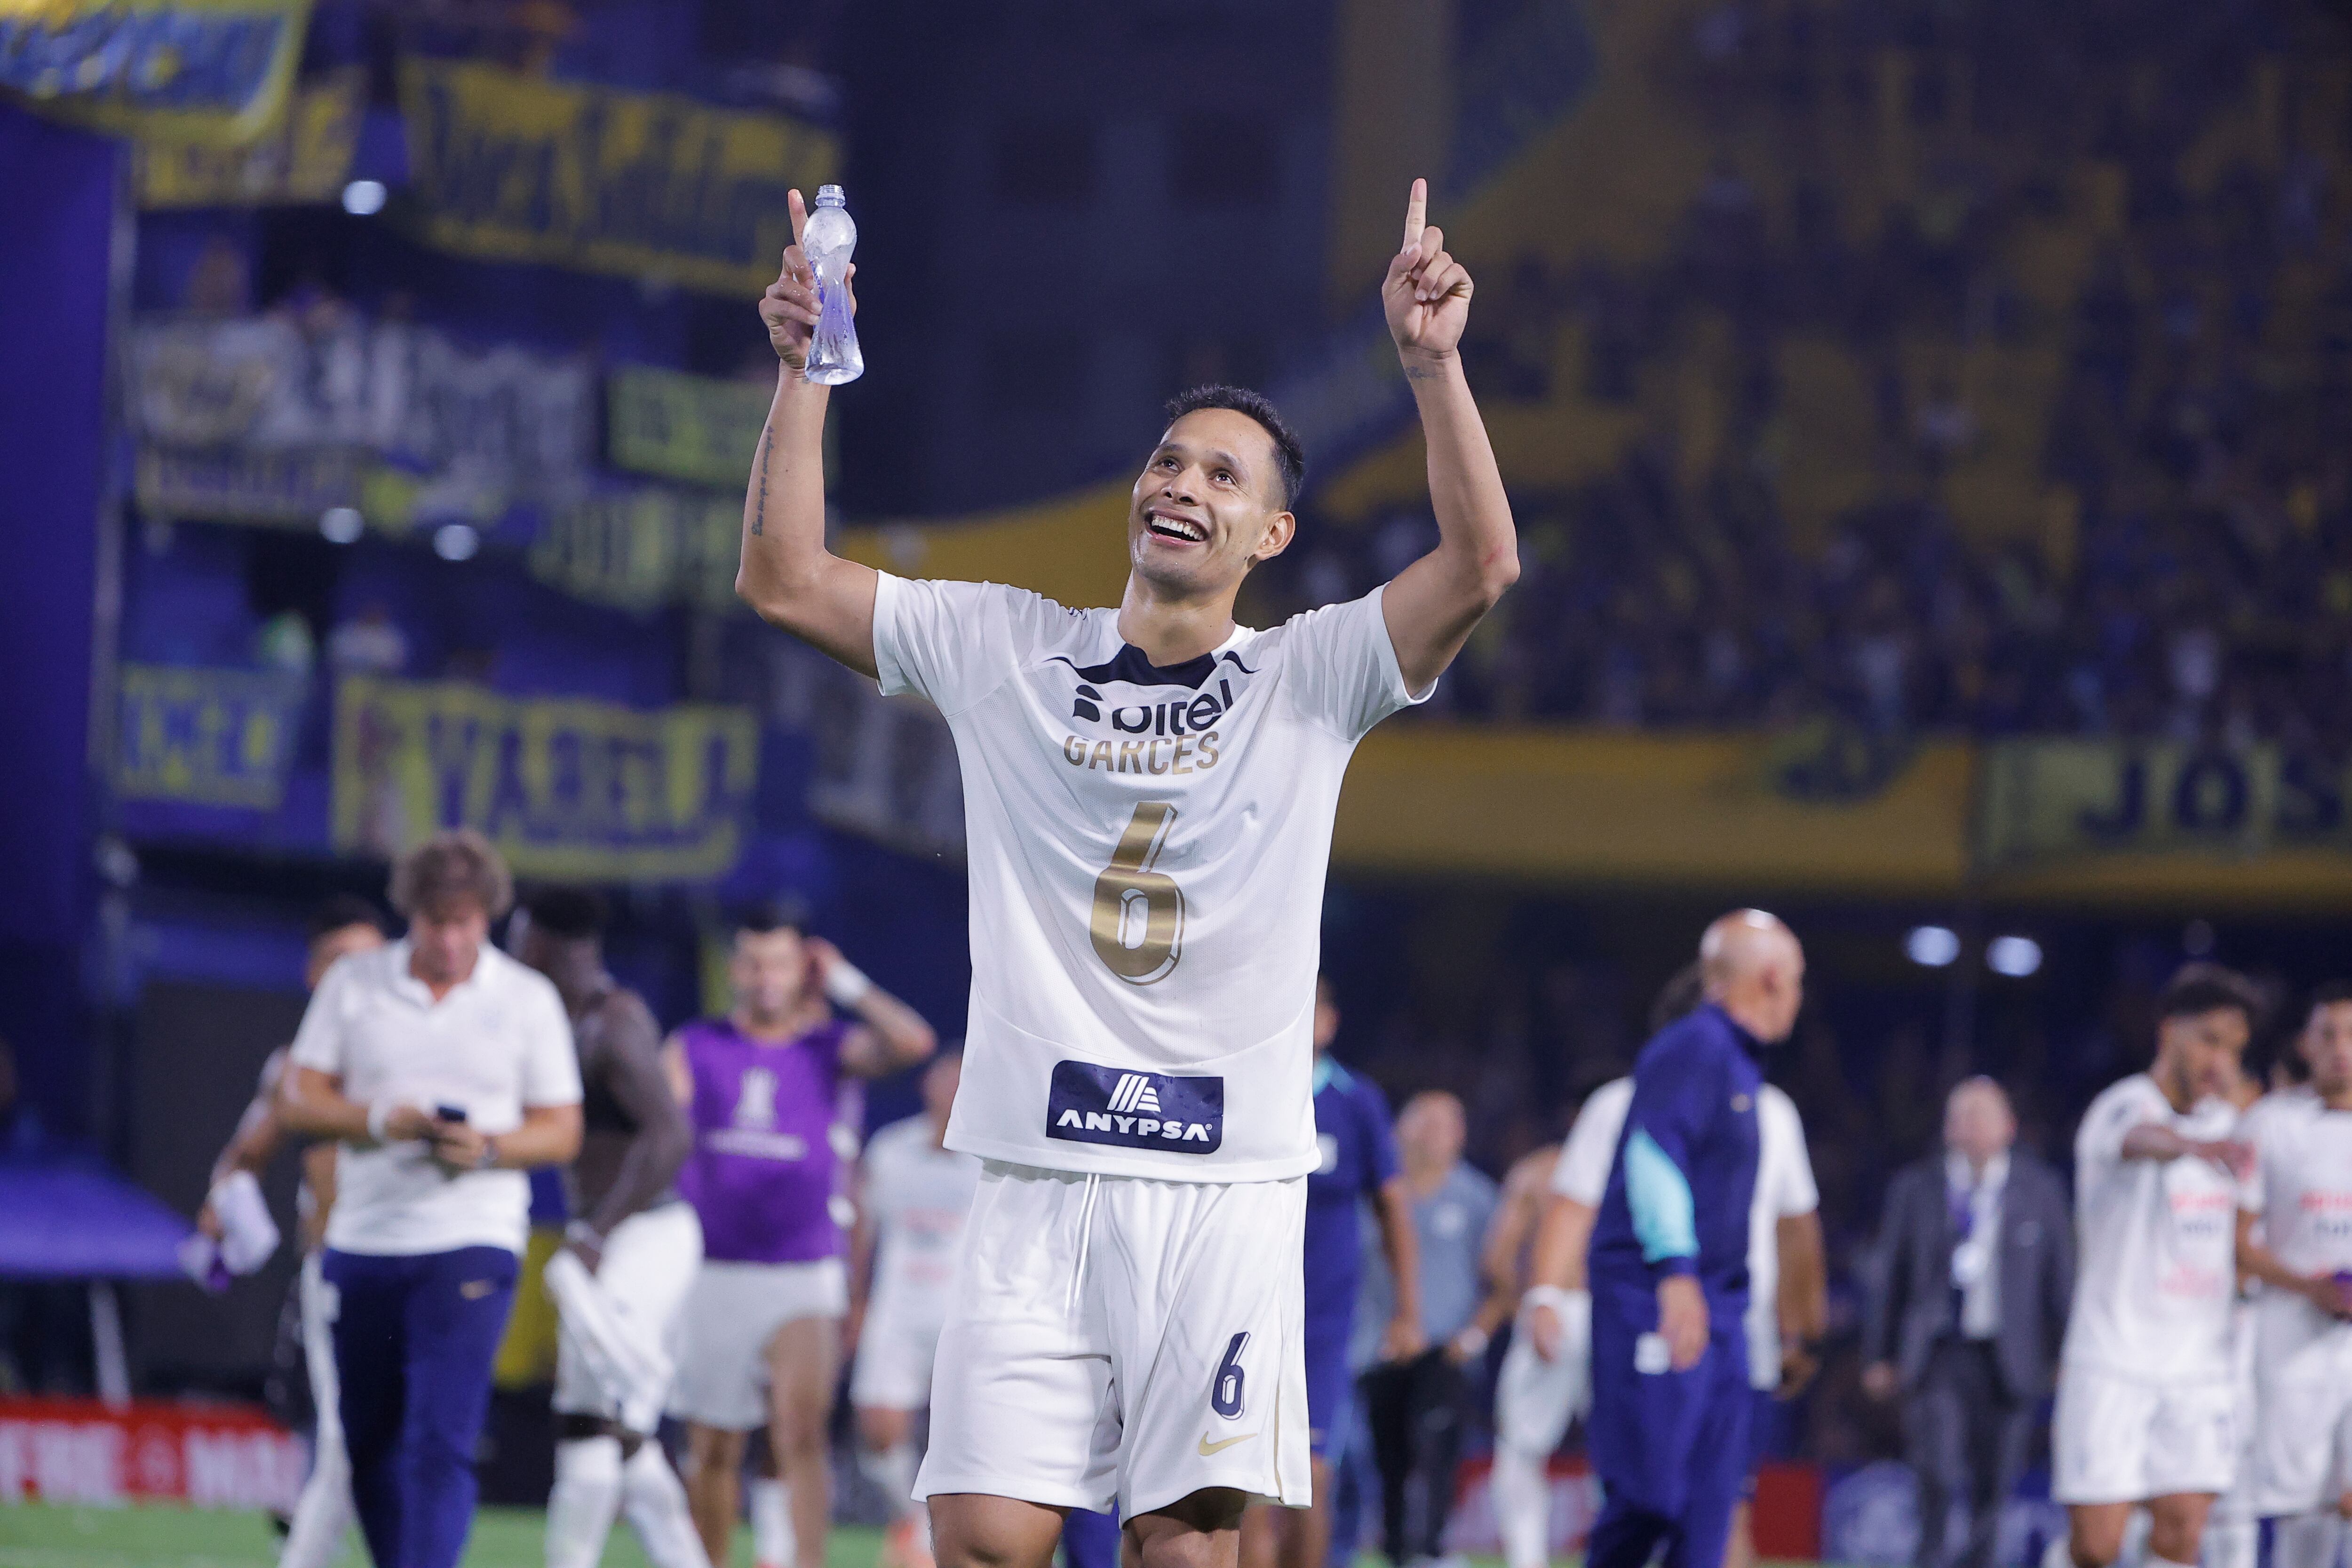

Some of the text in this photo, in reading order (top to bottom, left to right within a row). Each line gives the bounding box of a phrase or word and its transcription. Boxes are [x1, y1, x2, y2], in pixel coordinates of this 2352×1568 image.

[1064, 731, 1219, 775] GARCES
[1089, 801, 1185, 986] 6
[1211, 1331, 1250, 1420] 6
